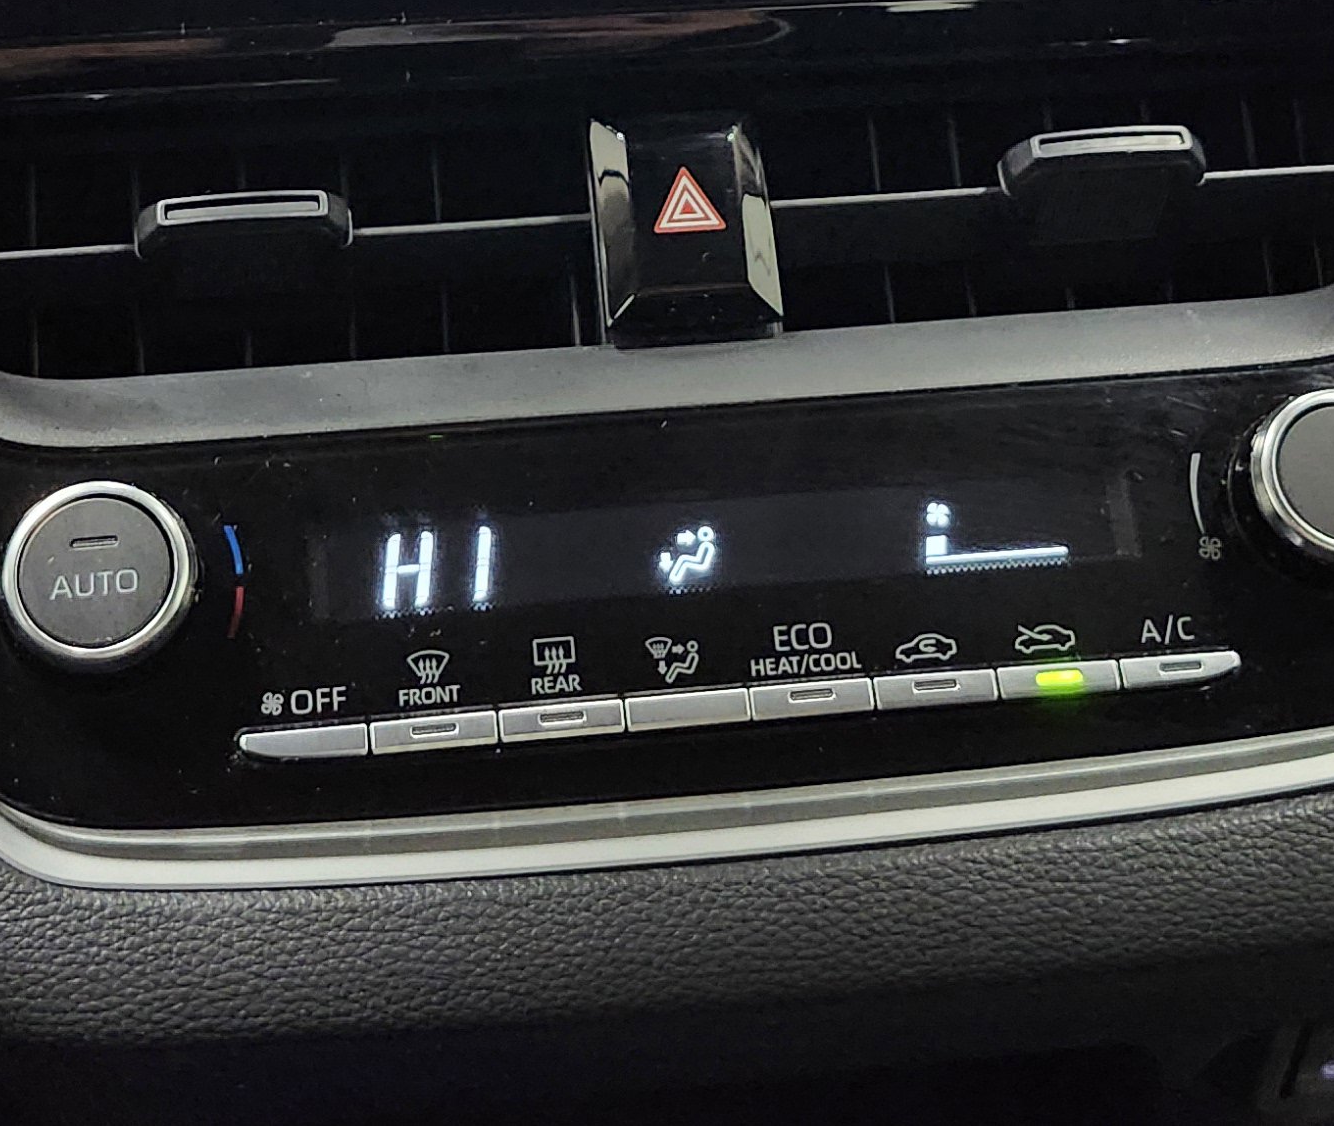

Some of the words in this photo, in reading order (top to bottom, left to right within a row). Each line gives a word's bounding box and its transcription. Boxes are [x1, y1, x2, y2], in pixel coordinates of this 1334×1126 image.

[48, 567, 140, 601] AUTO
[772, 622, 833, 652] ECO
[1140, 614, 1196, 645] A/C
[750, 650, 862, 678] HEAT/COOL
[398, 683, 462, 707] FRONT
[531, 673, 583, 696] REAR
[290, 685, 347, 716] OFF
